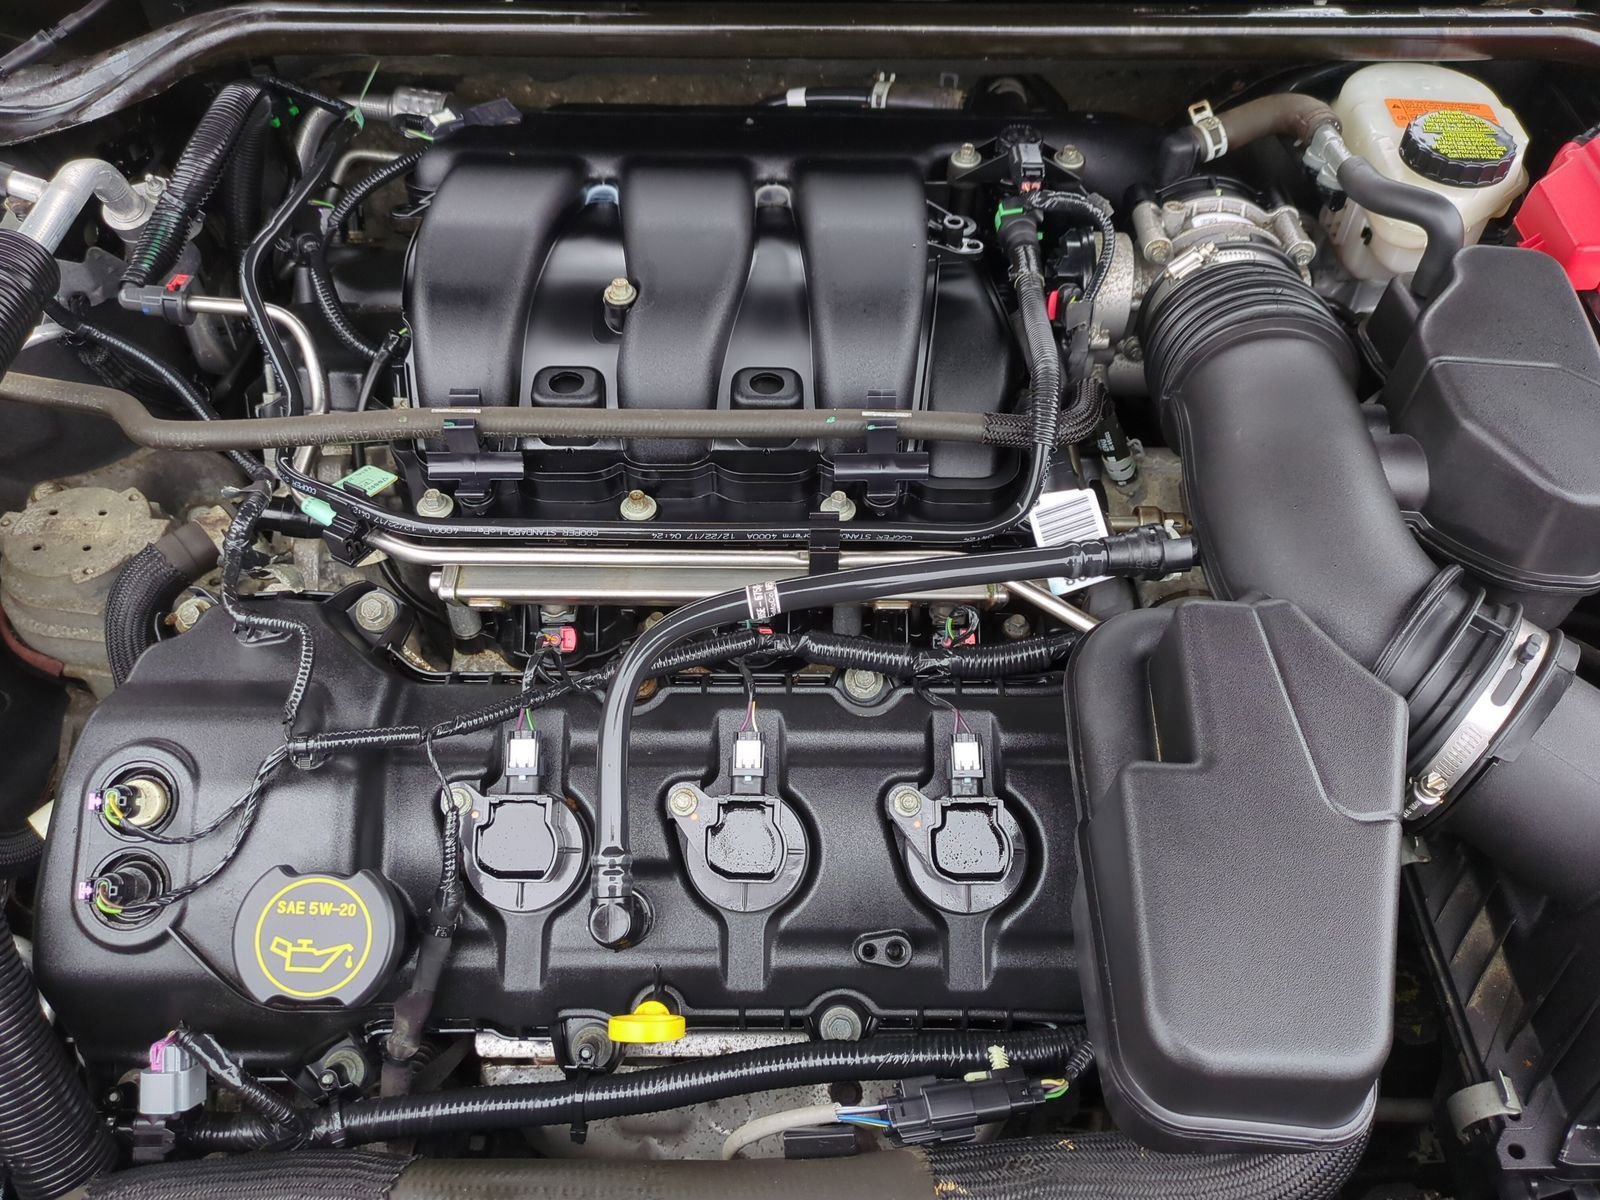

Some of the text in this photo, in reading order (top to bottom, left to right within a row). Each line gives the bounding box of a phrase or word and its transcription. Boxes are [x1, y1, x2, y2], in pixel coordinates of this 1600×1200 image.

[291, 479, 317, 495] COOPER
[349, 504, 600, 537] COOPER STANDARD LoPerm 4000A 12/22/17 04:2
[651, 532, 682, 540] 04:24
[687, 533, 736, 541] 12/22/17
[746, 533, 778, 541] 4000A
[840, 533, 872, 541] STAND
[277, 900, 357, 917] SAE 5W-20
